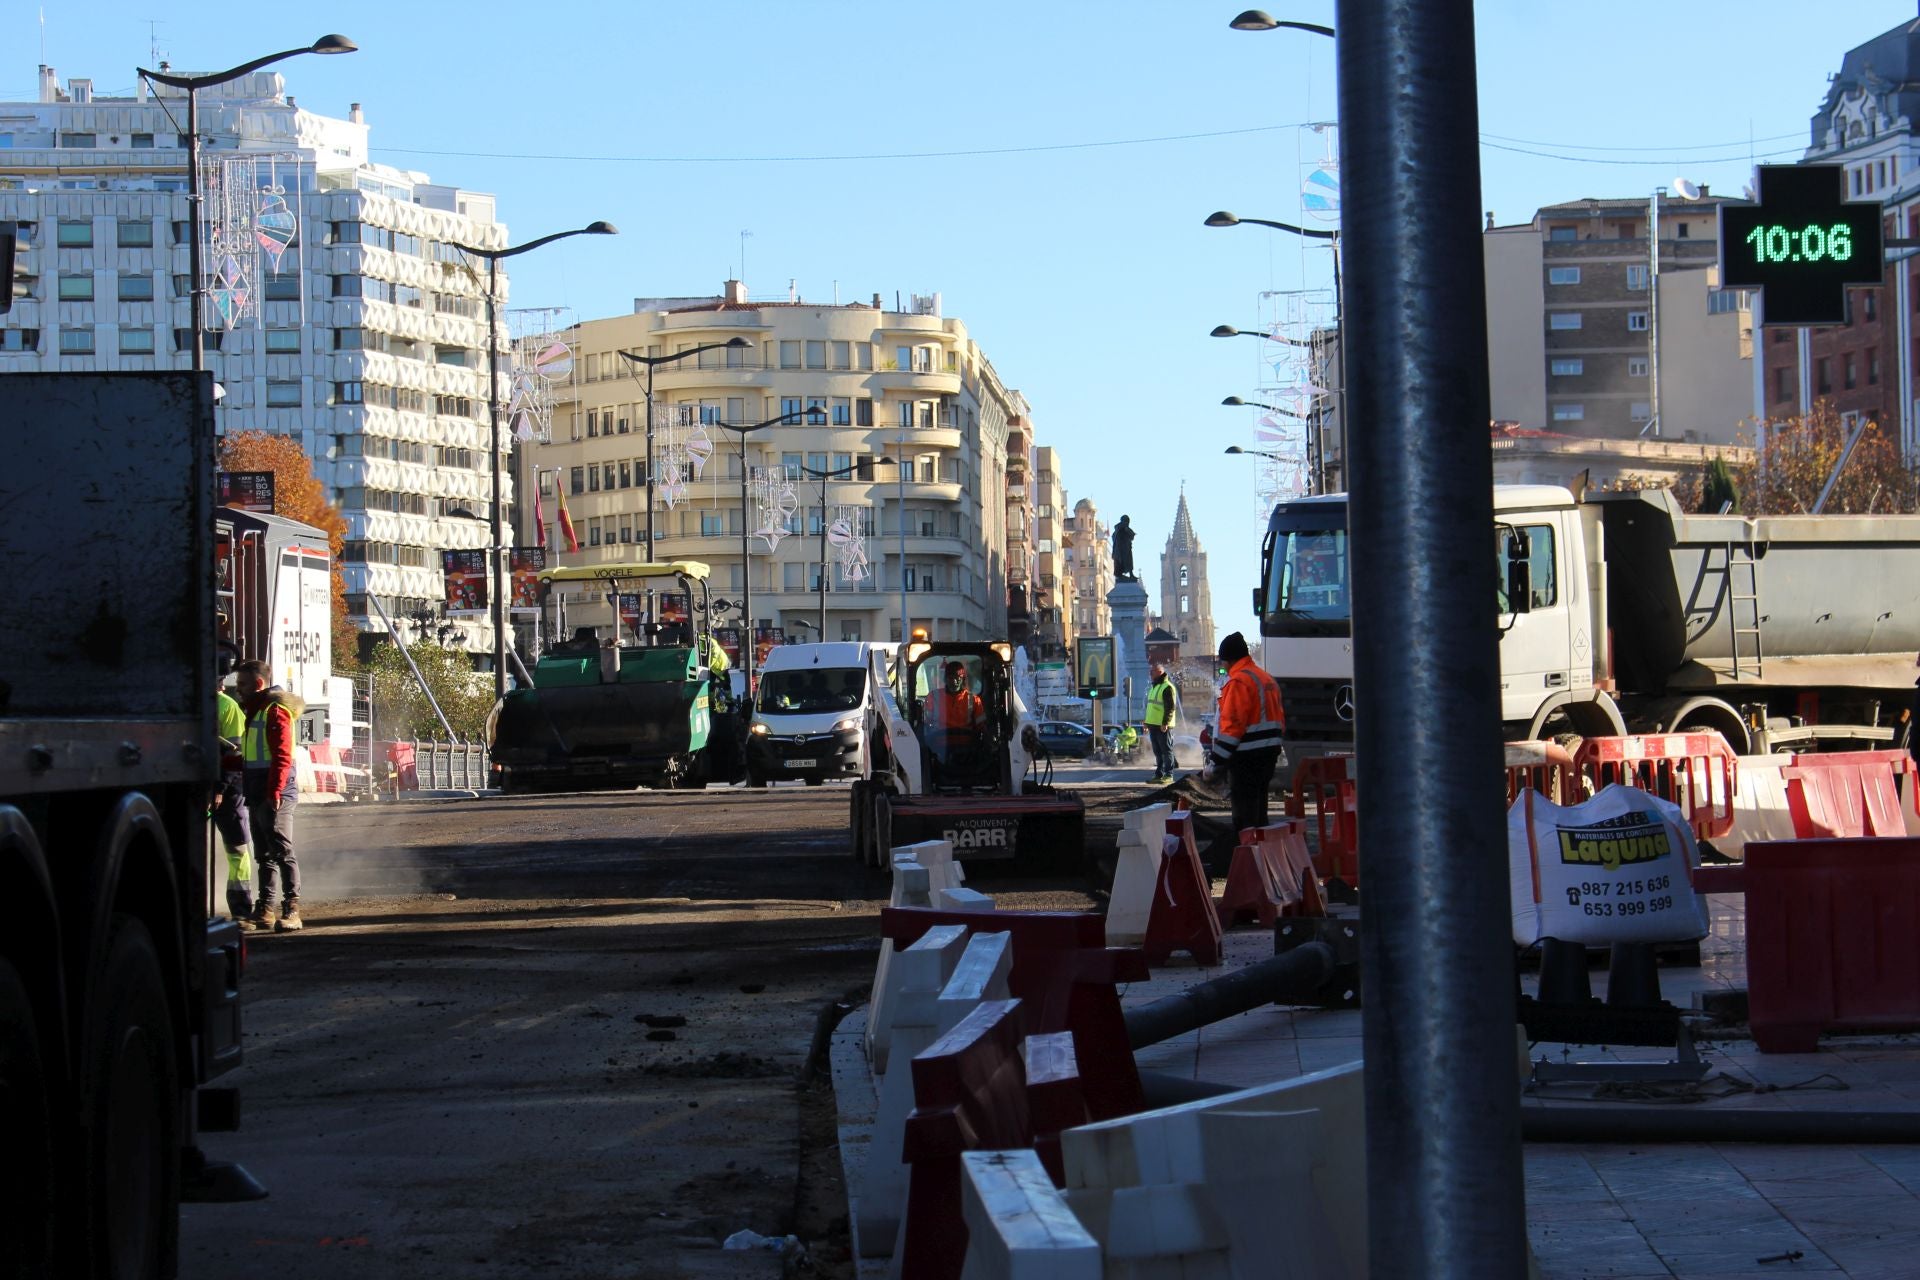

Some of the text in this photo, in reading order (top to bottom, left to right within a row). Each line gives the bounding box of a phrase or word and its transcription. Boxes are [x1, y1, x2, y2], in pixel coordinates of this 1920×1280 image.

[1746, 224, 1852, 263] 10:06
[255, 475, 267, 483] SA
[255, 482, 268, 490] BO
[255, 489, 272, 497] RES
[942, 828, 1018, 849] BARR
[1574, 832, 1615, 840] MATERIALES
[1616, 830, 1625, 839] DE
[1559, 831, 1671, 871] Laguna
[1581, 875, 1670, 896] 987 215 636
[1583, 895, 1673, 917] 653 999 599
